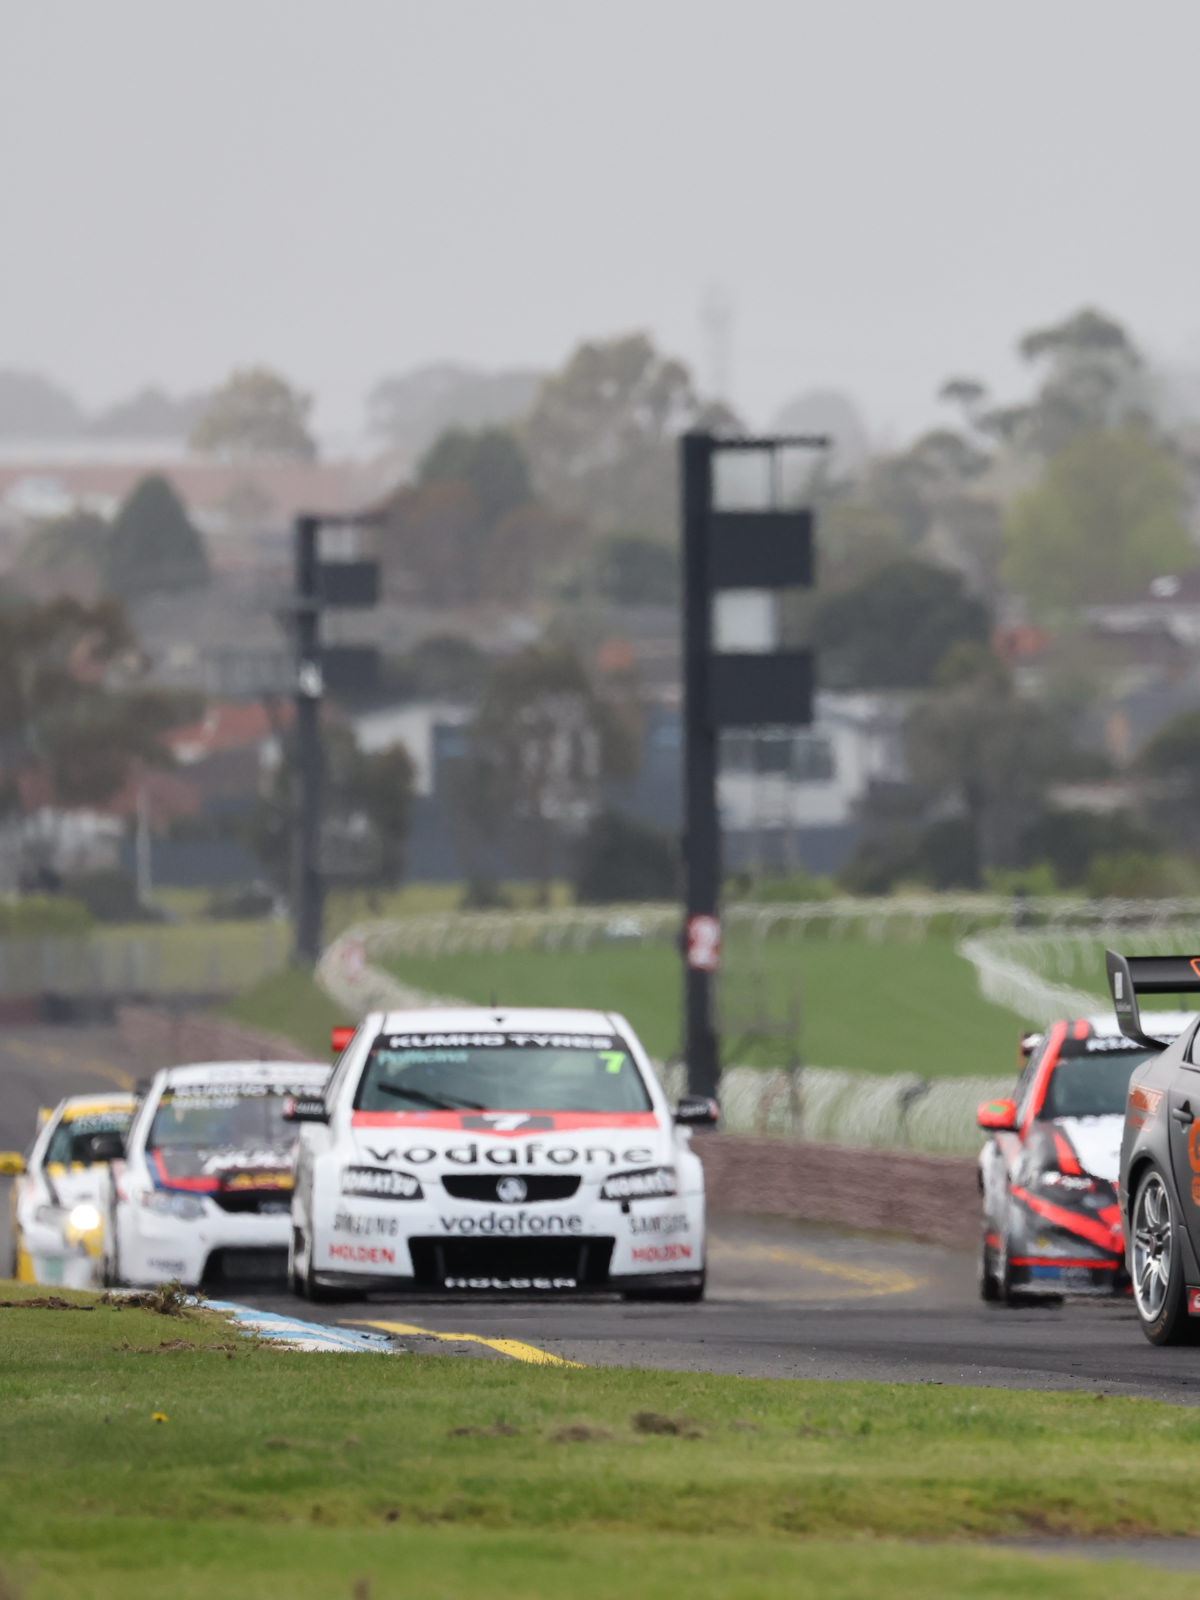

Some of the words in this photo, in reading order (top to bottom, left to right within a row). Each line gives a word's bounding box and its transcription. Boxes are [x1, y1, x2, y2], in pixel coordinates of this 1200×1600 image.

[389, 1033, 505, 1049] KUMHO
[506, 1033, 613, 1051] TYRES
[598, 1051, 626, 1074] 7
[482, 1112, 533, 1131] 7
[364, 1142, 655, 1165] vodafone
[440, 1211, 583, 1235] vodafone
[329, 1244, 395, 1264] HOLDEN
[631, 1245, 692, 1263] HOLDEN
[443, 1277, 578, 1289] HOLDEN
